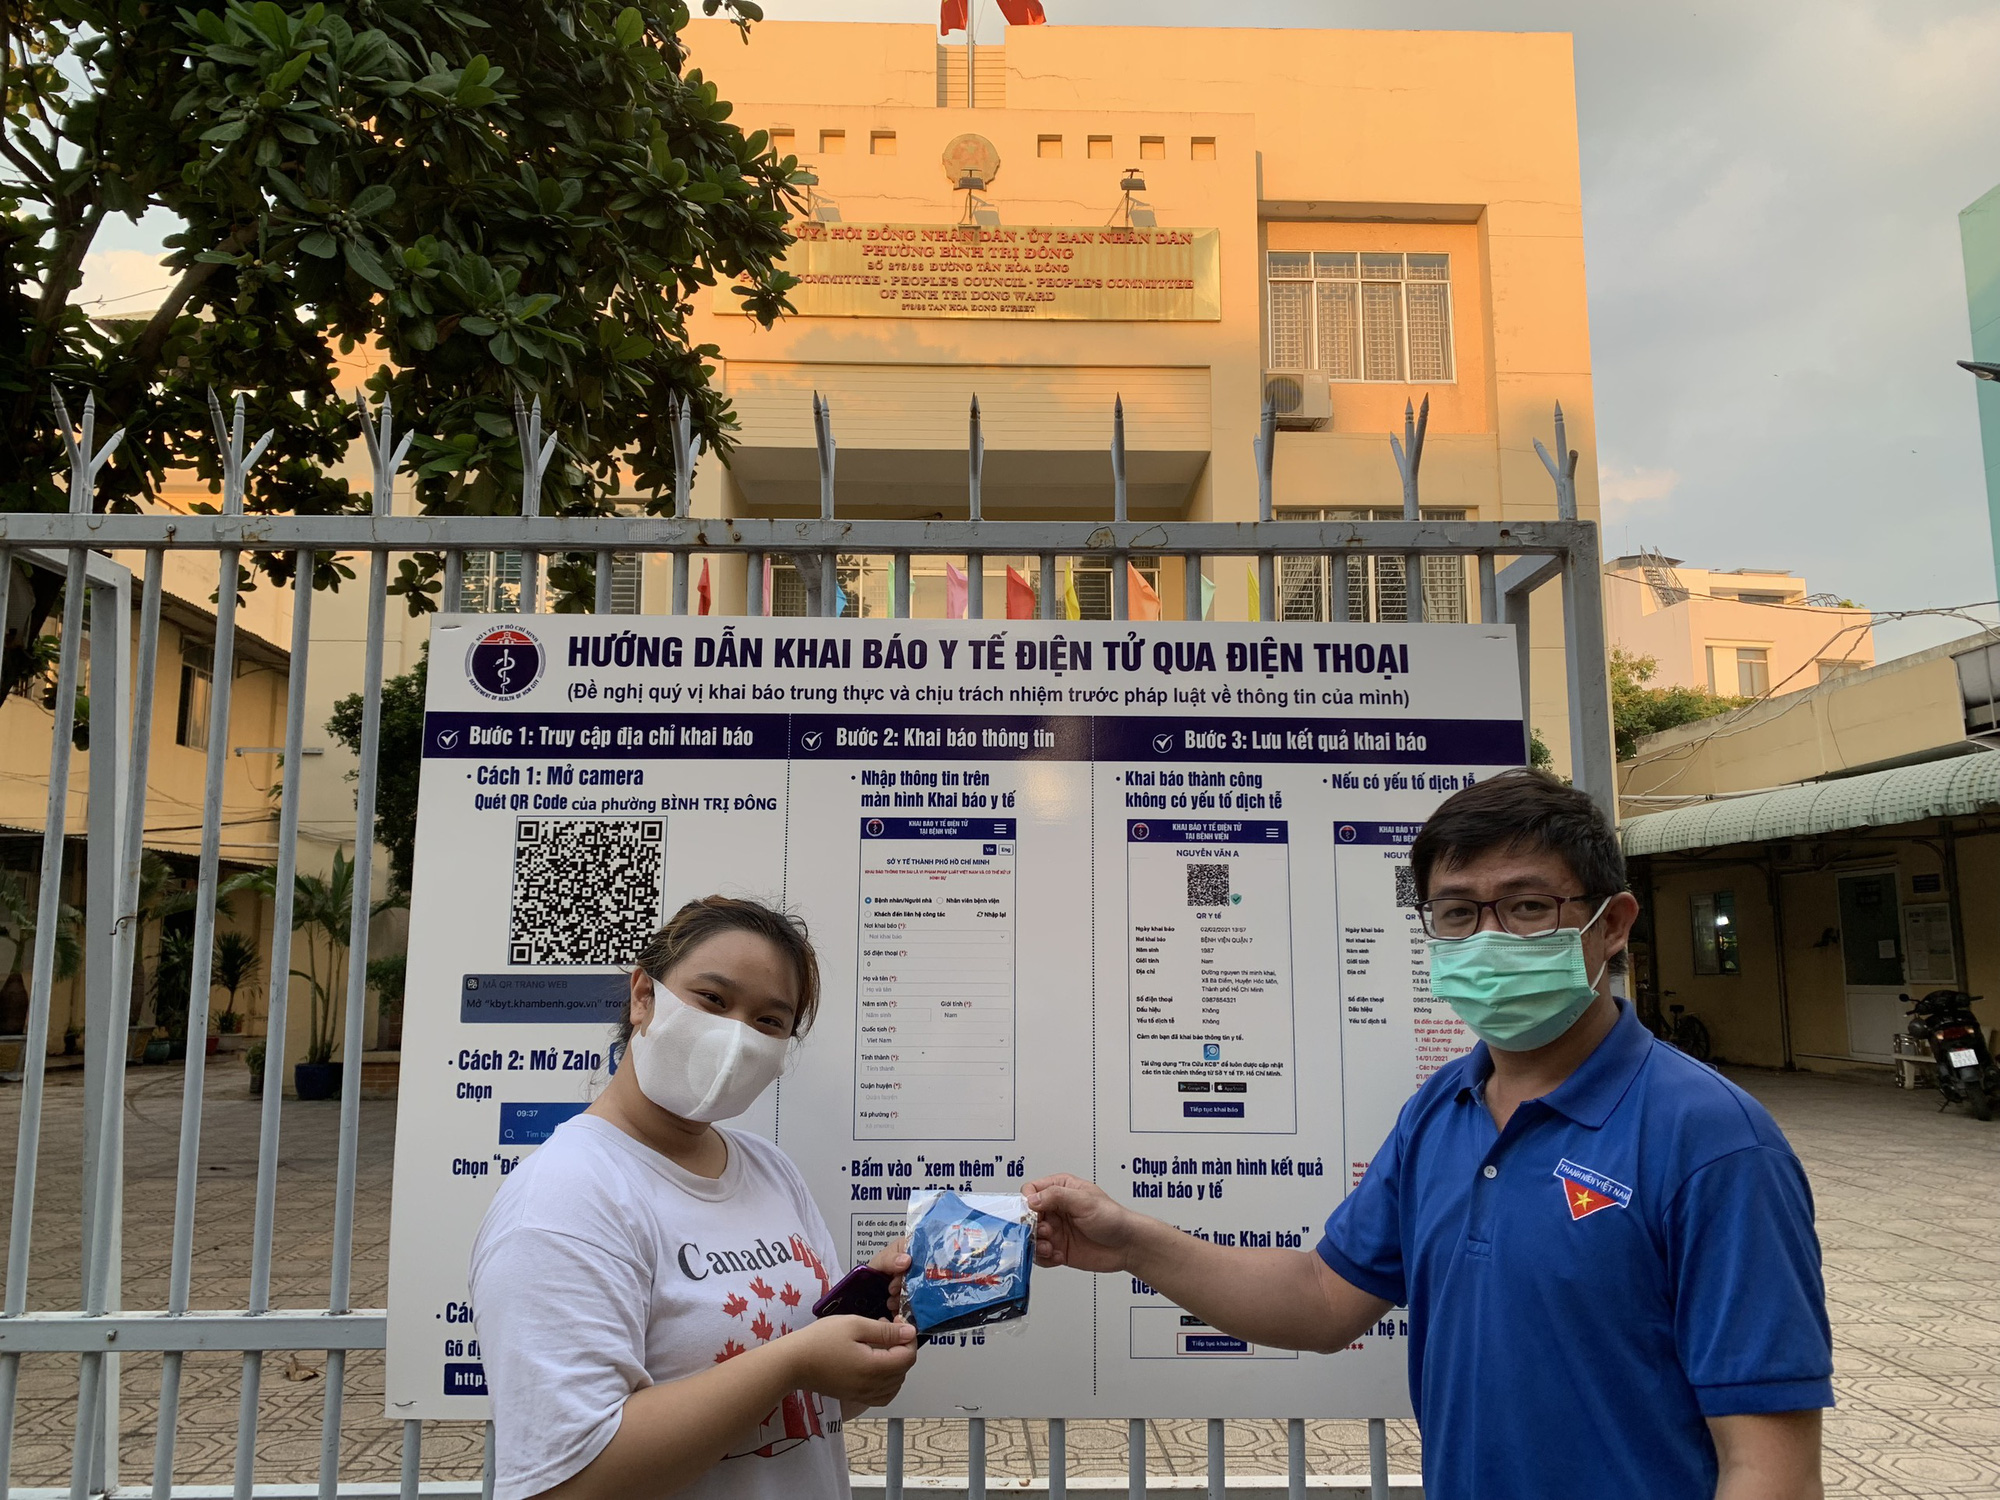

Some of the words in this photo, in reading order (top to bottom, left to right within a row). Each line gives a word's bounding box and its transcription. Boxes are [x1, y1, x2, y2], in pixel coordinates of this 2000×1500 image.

[831, 226, 862, 242] HỘI
[867, 225, 916, 242] ĐỒNG
[921, 226, 974, 243] NHÂN
[979, 228, 1017, 243] DÂN
[1057, 232, 1094, 244] BAN
[1099, 230, 1151, 245] NHÂN
[1155, 231, 1193, 245] DÂN
[940, 243, 984, 259] BÌNH
[989, 247, 1019, 263] TRỊ
[1024, 246, 1074, 260] ĐÔNG
[890, 276, 959, 287] PEOPLE'S
[963, 277, 1027, 288] COUNCIL
[1036, 278, 1103, 289] PEOPLE'S
[1106, 279, 1194, 290] COMMITTEE
[880, 289, 899, 300] OF
[902, 290, 939, 300] BINH
[942, 290, 967, 301] TRI
[970, 291, 1010, 301] DONG
[1014, 291, 1056, 302] WARD
[568, 630, 683, 667] HƯỚNG
[693, 625, 763, 668] DẪN
[774, 638, 851, 669] KHAI
[862, 632, 928, 669] BÁO
[938, 639, 959, 670] Y
[968, 630, 1008, 670] TẾ
[1015, 634, 1092, 677] ĐIỆN
[1103, 631, 1146, 671] TỬ
[1153, 641, 1217, 675] QUA
[1226, 636, 1303, 679] ĐIỆN
[1313, 643, 1409, 680] THOẠI
[568, 679, 598, 702] (Đề
[603, 683, 643, 704] nghị
[648, 683, 682, 704] quý
[687, 684, 703, 703] vị
[709, 683, 746, 700] khai
[752, 684, 785, 700] báo
[790, 685, 838, 704] trung
[843, 685, 885, 704] thực
[890, 685, 910, 701] và
[915, 685, 953, 705] chịu
[959, 685, 1004, 702] trách
[1009, 686, 1063, 706] nhiệm
[1068, 686, 1119, 703] trước
[1124, 687, 1168, 706] pháp
[1174, 688, 1206, 707] luật
[1211, 683, 1232, 703] về
[1237, 688, 1288, 707] thông
[1294, 688, 1316, 704] tin
[1322, 688, 1353, 705] của
[1359, 689, 1410, 709] mình)
[469, 725, 513, 746] Bước
[519, 727, 534, 746] 1:
[539, 727, 576, 749] Truy
[580, 727, 611, 749] cập
[617, 726, 643, 749] địa
[649, 723, 676, 746] chỉ
[680, 726, 717, 746] khai
[723, 727, 754, 746] báo
[836, 727, 878, 747] Bước
[883, 729, 899, 747] 2:
[904, 728, 941, 747] Khai
[947, 728, 977, 747] báo
[982, 728, 1029, 750] thông
[1033, 729, 1055, 748] tin
[1185, 729, 1227, 750] Bước
[1232, 731, 1247, 750] 3:
[1252, 731, 1282, 750] Lưu
[1287, 729, 1314, 751] kết
[1318, 729, 1349, 752] quả
[1354, 732, 1391, 751] khai
[1396, 732, 1427, 752] báo
[477, 765, 520, 786] Cách
[526, 766, 541, 786] 1:
[547, 764, 574, 786] Mở
[579, 768, 644, 786] camera
[861, 770, 897, 789] Nhập
[900, 770, 938, 788] thông
[941, 771, 960, 786] tin
[963, 771, 990, 786] trên
[1125, 771, 1156, 787] Khai
[1159, 771, 1184, 788] báo
[1188, 771, 1226, 788] thành
[1229, 771, 1263, 790] công
[1332, 772, 1359, 789] Nếu
[1363, 773, 1380, 790] có
[1384, 773, 1408, 792] yếu
[1411, 773, 1426, 790] tố
[1428, 774, 1459, 794] dịch
[475, 793, 506, 812] Quét
[510, 794, 529, 812] QR
[533, 793, 568, 811] Code
[571, 797, 597, 812] của
[602, 797, 657, 814] phường
[661, 794, 700, 811] BÌNH
[704, 797, 730, 814] TRỊ
[733, 793, 777, 812] ĐÔNG
[861, 791, 890, 808] màn
[894, 791, 924, 808] hình
[927, 791, 958, 808] Khai
[962, 791, 987, 808] báo
[990, 794, 999, 810] y
[1002, 789, 1017, 808] tế
[1125, 792, 1167, 810] không
[1170, 792, 1187, 809] có
[1190, 790, 1216, 811] yếu
[1218, 791, 1233, 809] tố
[1236, 792, 1266, 812] dịch
[1269, 790, 1283, 809] tễ
[1176, 847, 1212, 858] NGUYỄN
[1213, 849, 1232, 858] VĂN
[1232, 850, 1240, 858] A
[499, 981, 514, 989] QR
[515, 981, 545, 989] TRANG
[547, 981, 568, 989] WEB
[458, 1049, 502, 1071] Cách
[507, 1051, 524, 1071] 2:
[530, 1047, 558, 1071] Mở
[562, 1050, 601, 1071] Zalo
[456, 1082, 493, 1103] Chọn
[516, 1110, 539, 1118] 09:37
[452, 1158, 489, 1179] Chọn
[851, 1157, 885, 1178] Bấm
[887, 1159, 913, 1178] vào
[917, 1155, 953, 1178] “xem
[959, 1155, 1003, 1178] thêm”
[1007, 1156, 1025, 1178] để
[1132, 1157, 1168, 1178] Chụp
[1172, 1155, 1198, 1176] ảnh
[1202, 1157, 1232, 1176] màn
[1236, 1158, 1267, 1176] hình
[1271, 1157, 1294, 1177] kết
[1297, 1156, 1324, 1178] quả
[1560, 1163, 1582, 1178] THANH
[1594, 1180, 1614, 1192] VIỆT
[851, 1184, 885, 1201] Xem
[1132, 1181, 1163, 1199] khai
[1167, 1180, 1193, 1199] báo
[1197, 1184, 1206, 1201] y
[1208, 1179, 1225, 1199] tế
[1240, 1231, 1271, 1248] Khai
[1276, 1226, 1310, 1248] báo”
[677, 1239, 792, 1281] Canada
[445, 1339, 464, 1357] Gõ
